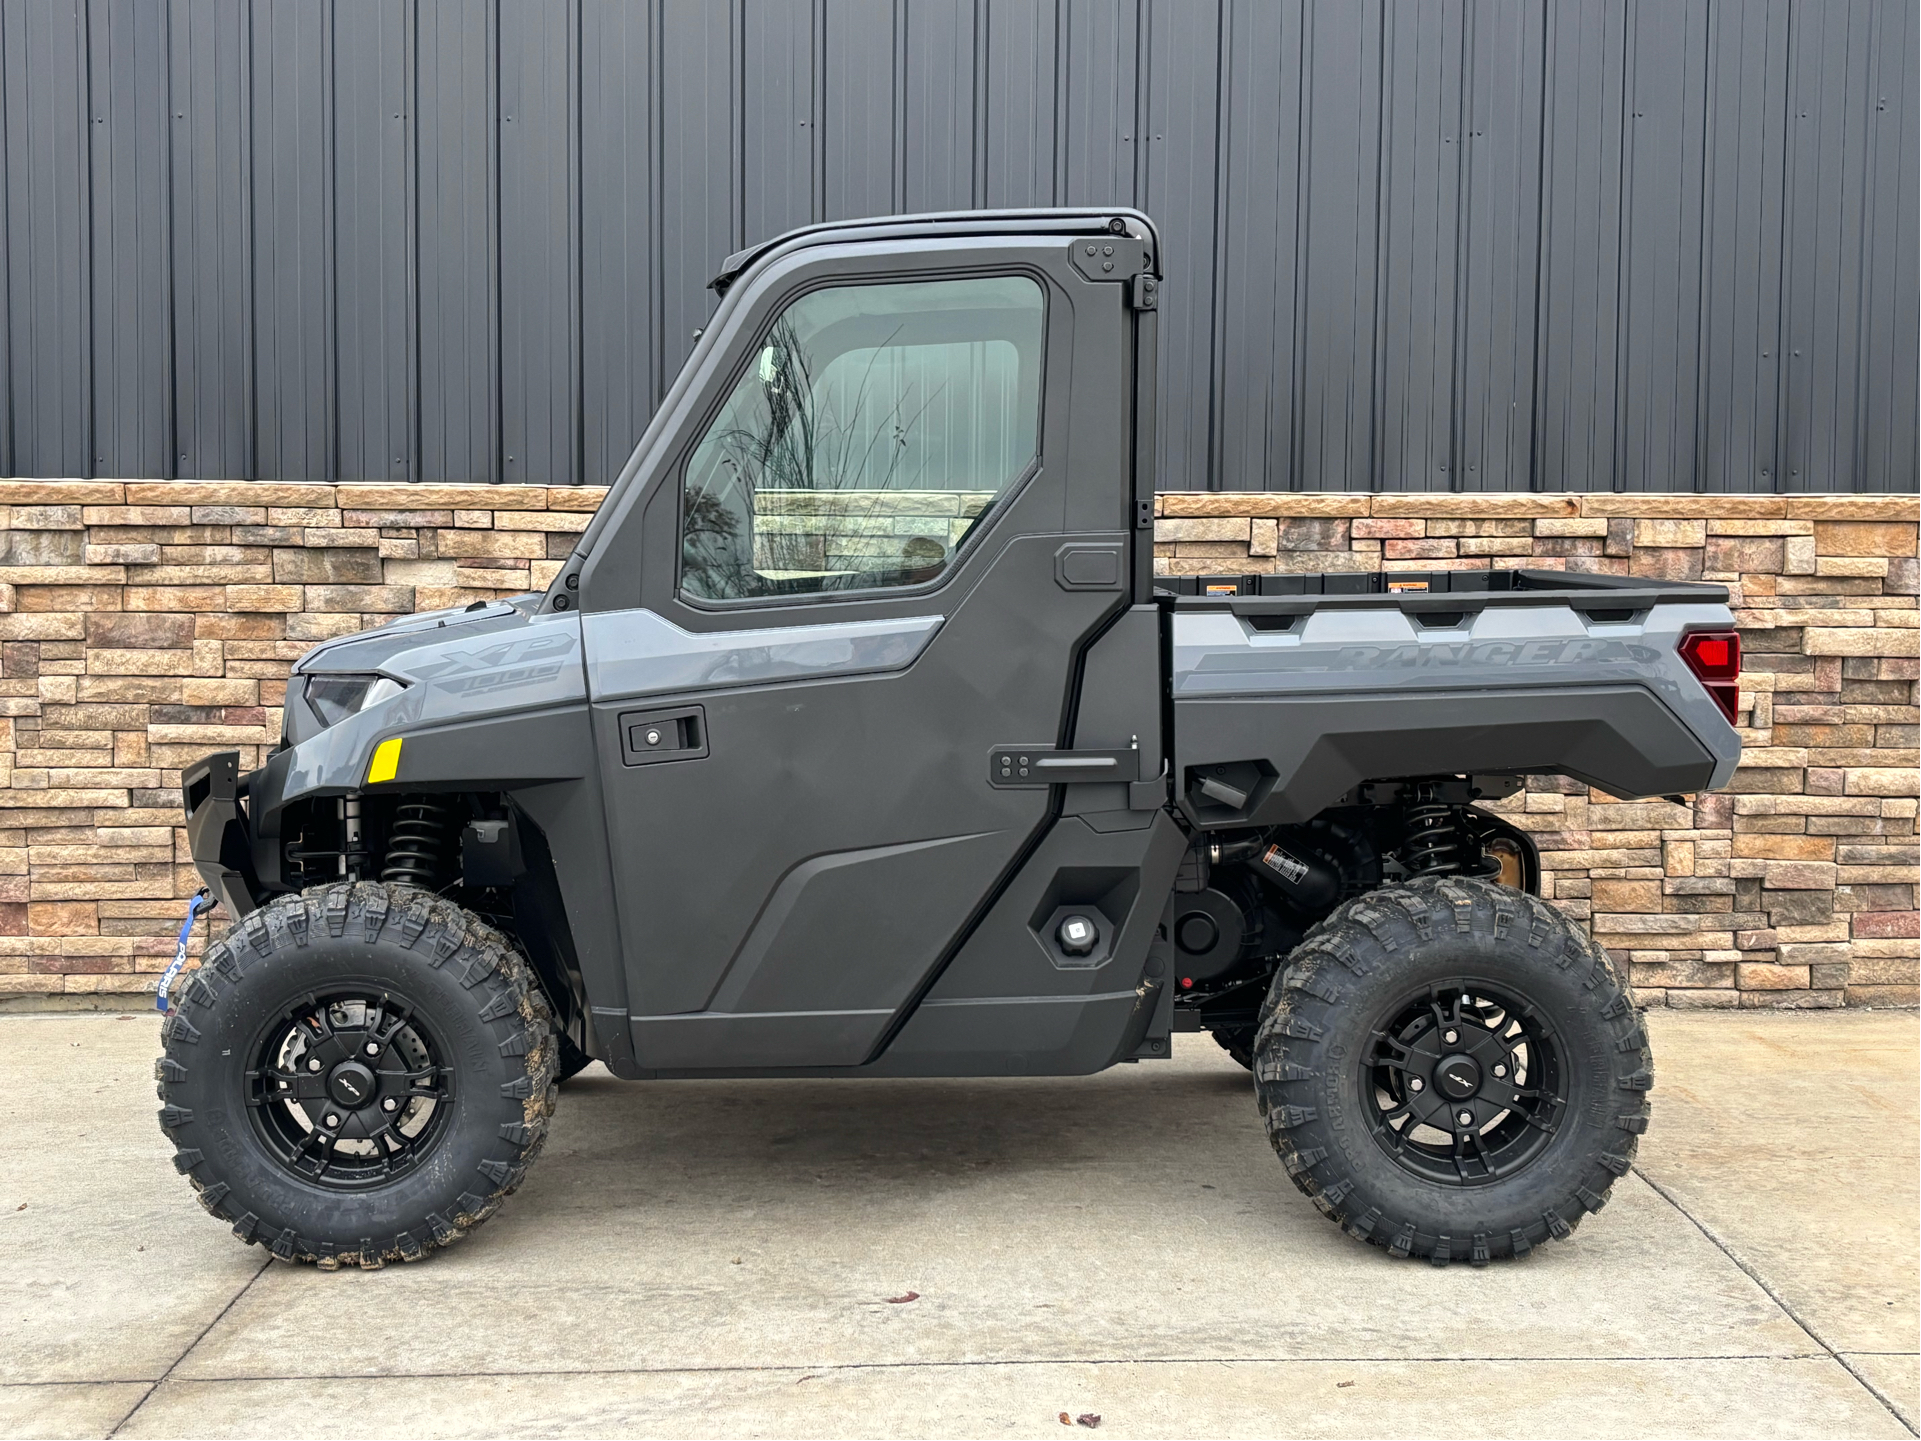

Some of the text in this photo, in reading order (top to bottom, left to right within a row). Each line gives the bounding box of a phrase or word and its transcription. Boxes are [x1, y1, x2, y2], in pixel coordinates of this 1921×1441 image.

[428, 633, 574, 679] XP
[1337, 639, 1608, 671] RANGER
[462, 661, 563, 691] 1000
[159, 942, 186, 998] POLARIS
